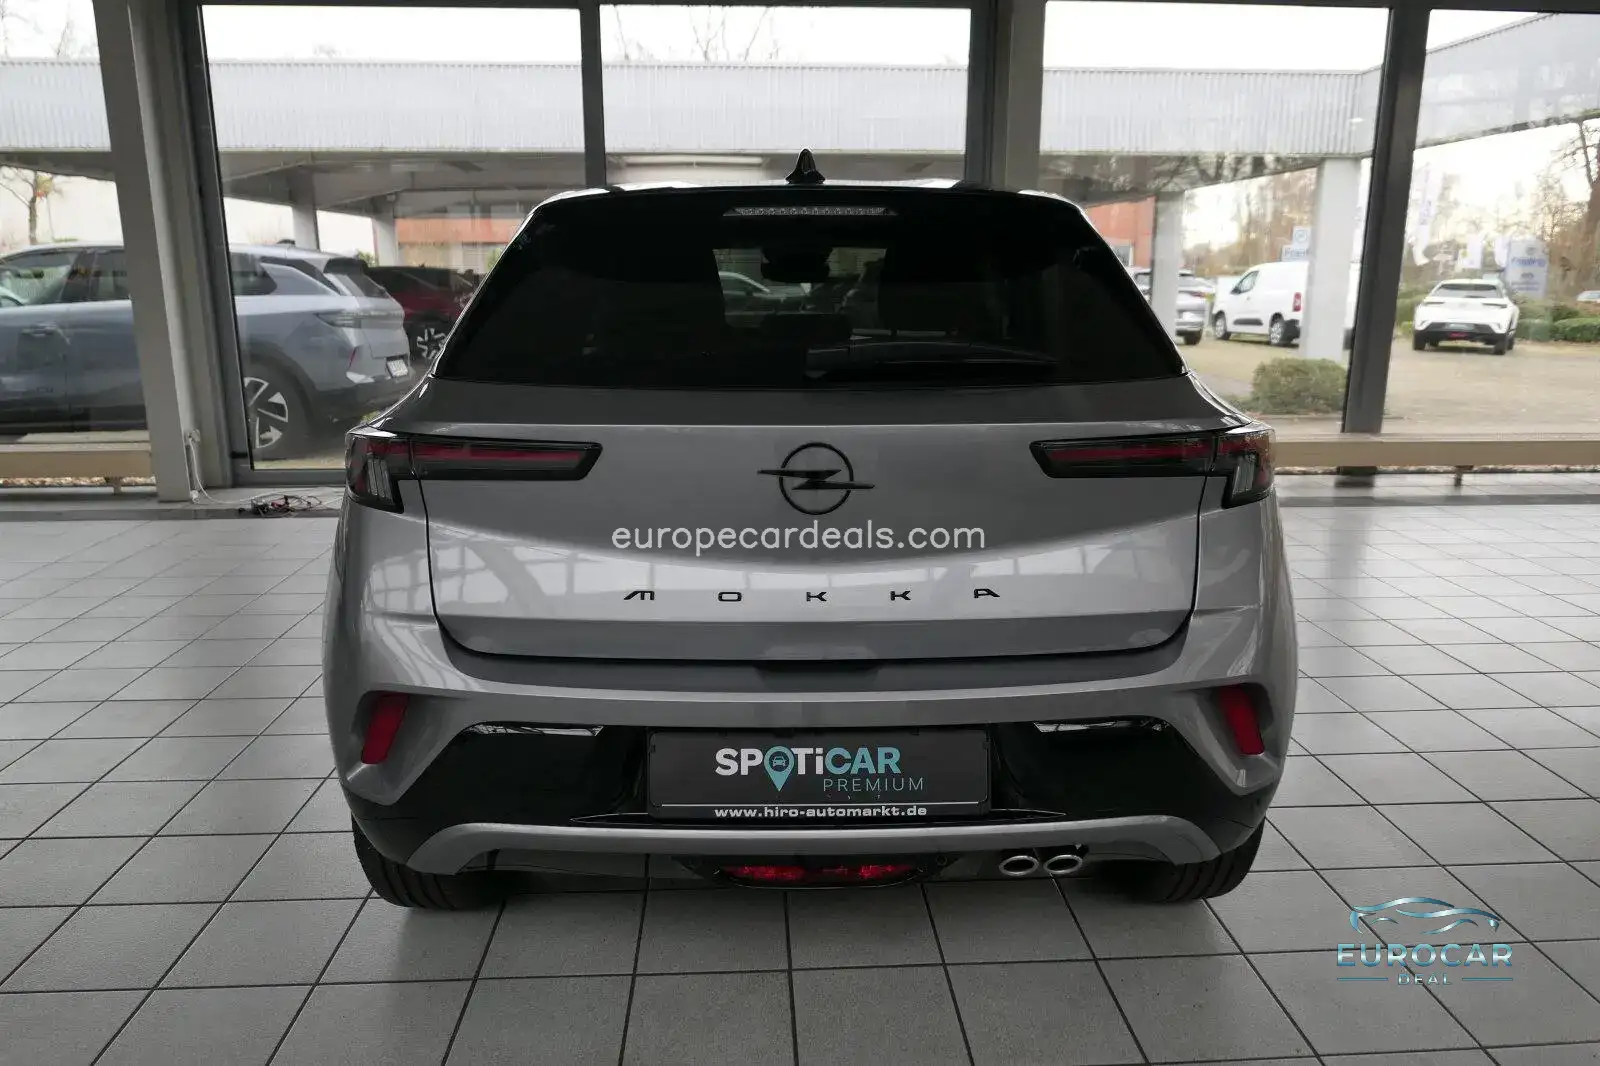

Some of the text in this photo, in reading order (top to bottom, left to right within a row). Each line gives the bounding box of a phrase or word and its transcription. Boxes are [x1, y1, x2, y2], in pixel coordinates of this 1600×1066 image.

[623, 588, 1001, 602] MOKKA
[823, 777, 924, 792] PREMIUM
[714, 805, 927, 818] www.hiro-automarkt.de
